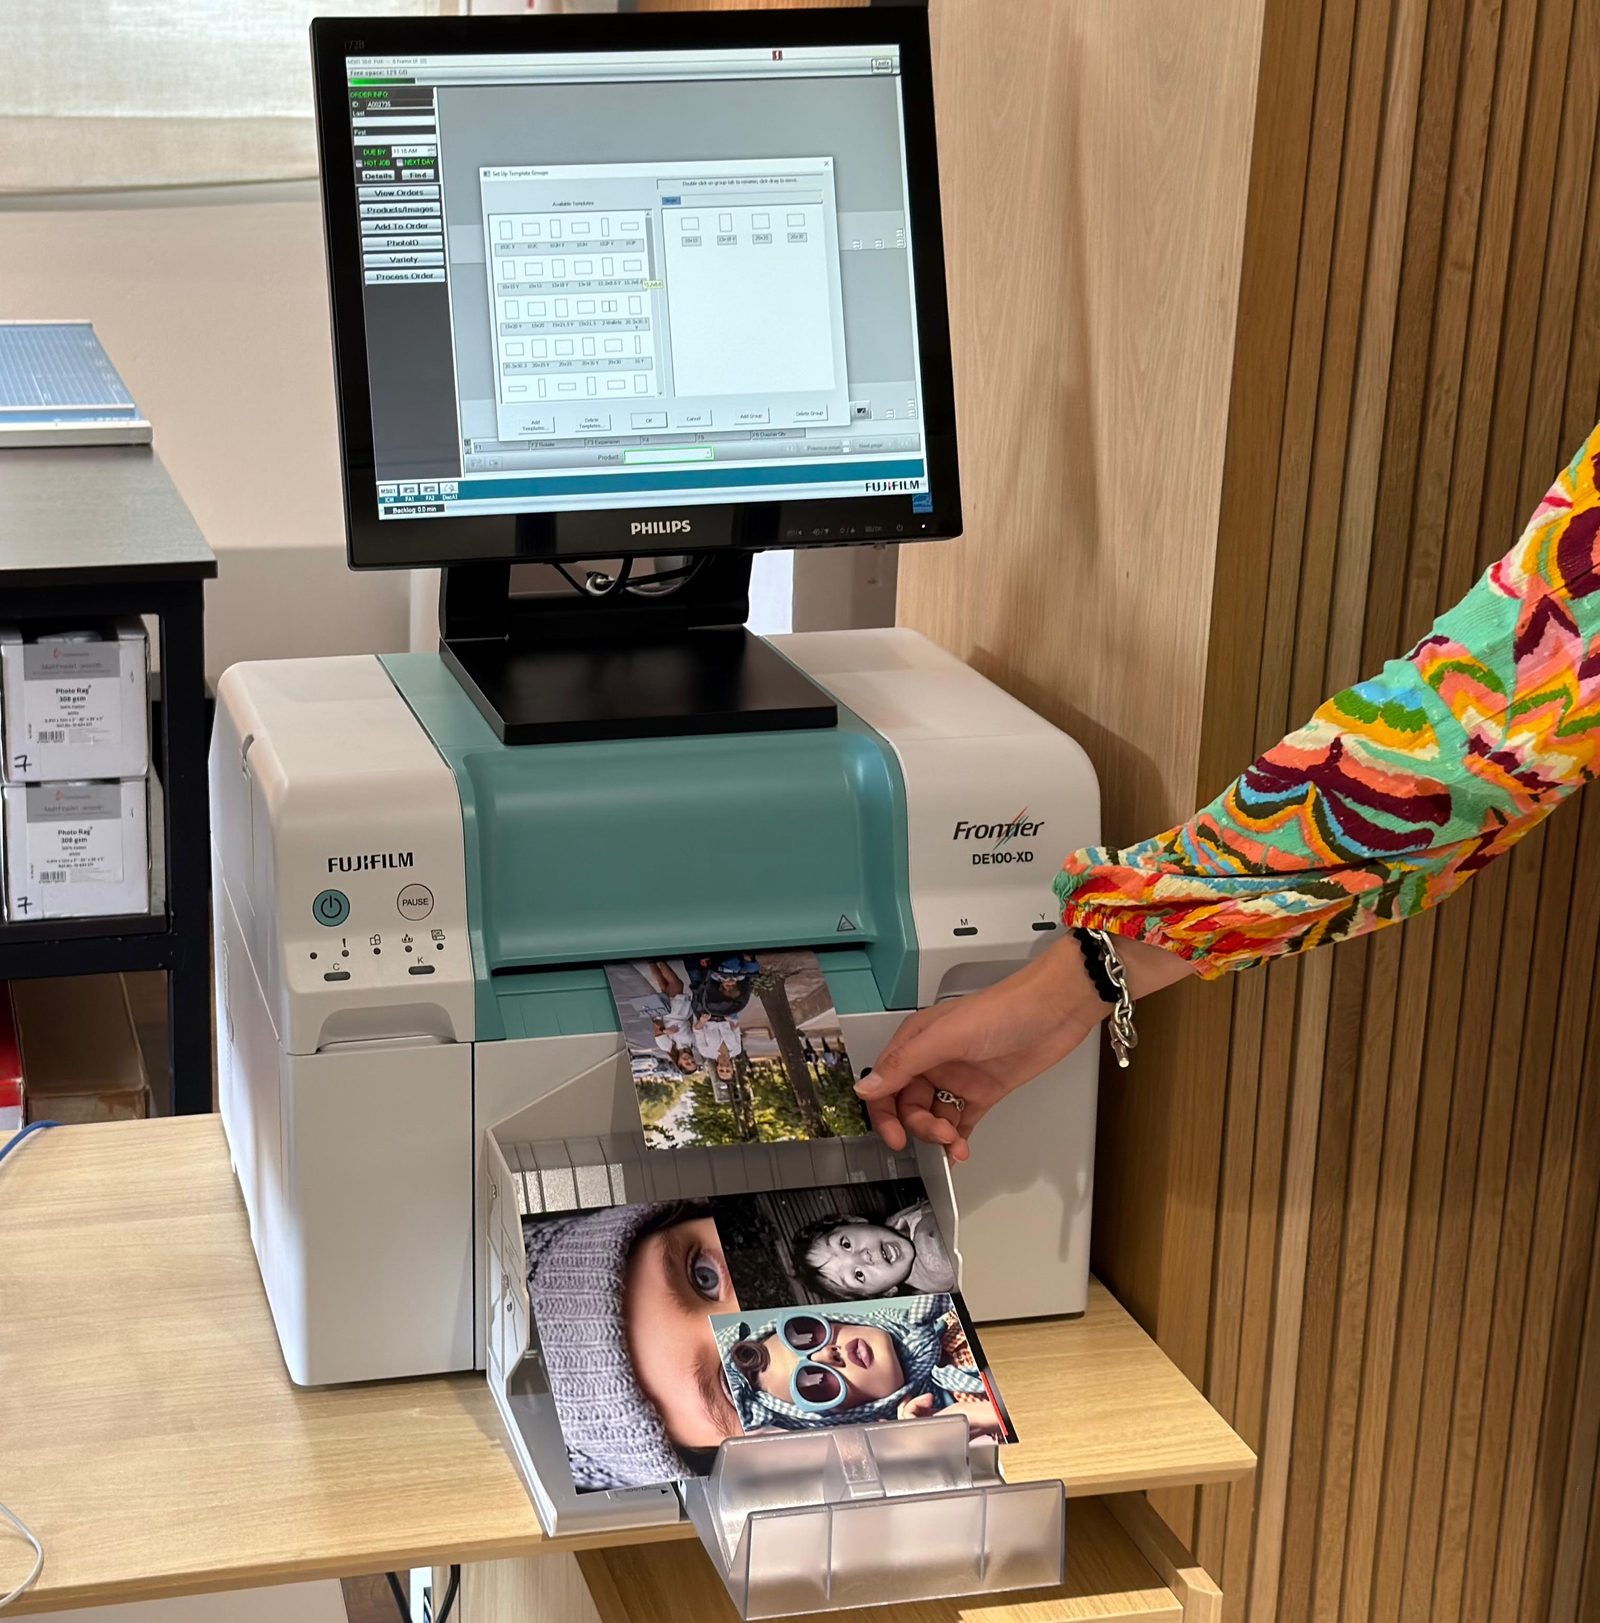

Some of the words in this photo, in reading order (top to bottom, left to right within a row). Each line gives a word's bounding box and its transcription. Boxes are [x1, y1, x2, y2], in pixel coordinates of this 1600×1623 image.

[366, 205, 434, 214] Products/Images
[386, 239, 419, 247] PhotoID
[389, 256, 418, 264] Variety
[865, 480, 919, 492] FUJIFILM
[631, 519, 691, 536] PHILIPS
[14, 754, 32, 772] 7
[953, 820, 1044, 841] Frontier
[328, 852, 414, 872] FUJIFILM
[972, 851, 1034, 865] DE100-XD
[17, 896, 32, 914] 7
[402, 898, 429, 906] PAUSE
[960, 918, 969, 926] M
[1040, 913, 1046, 921] Y
[332, 963, 340, 971] C
